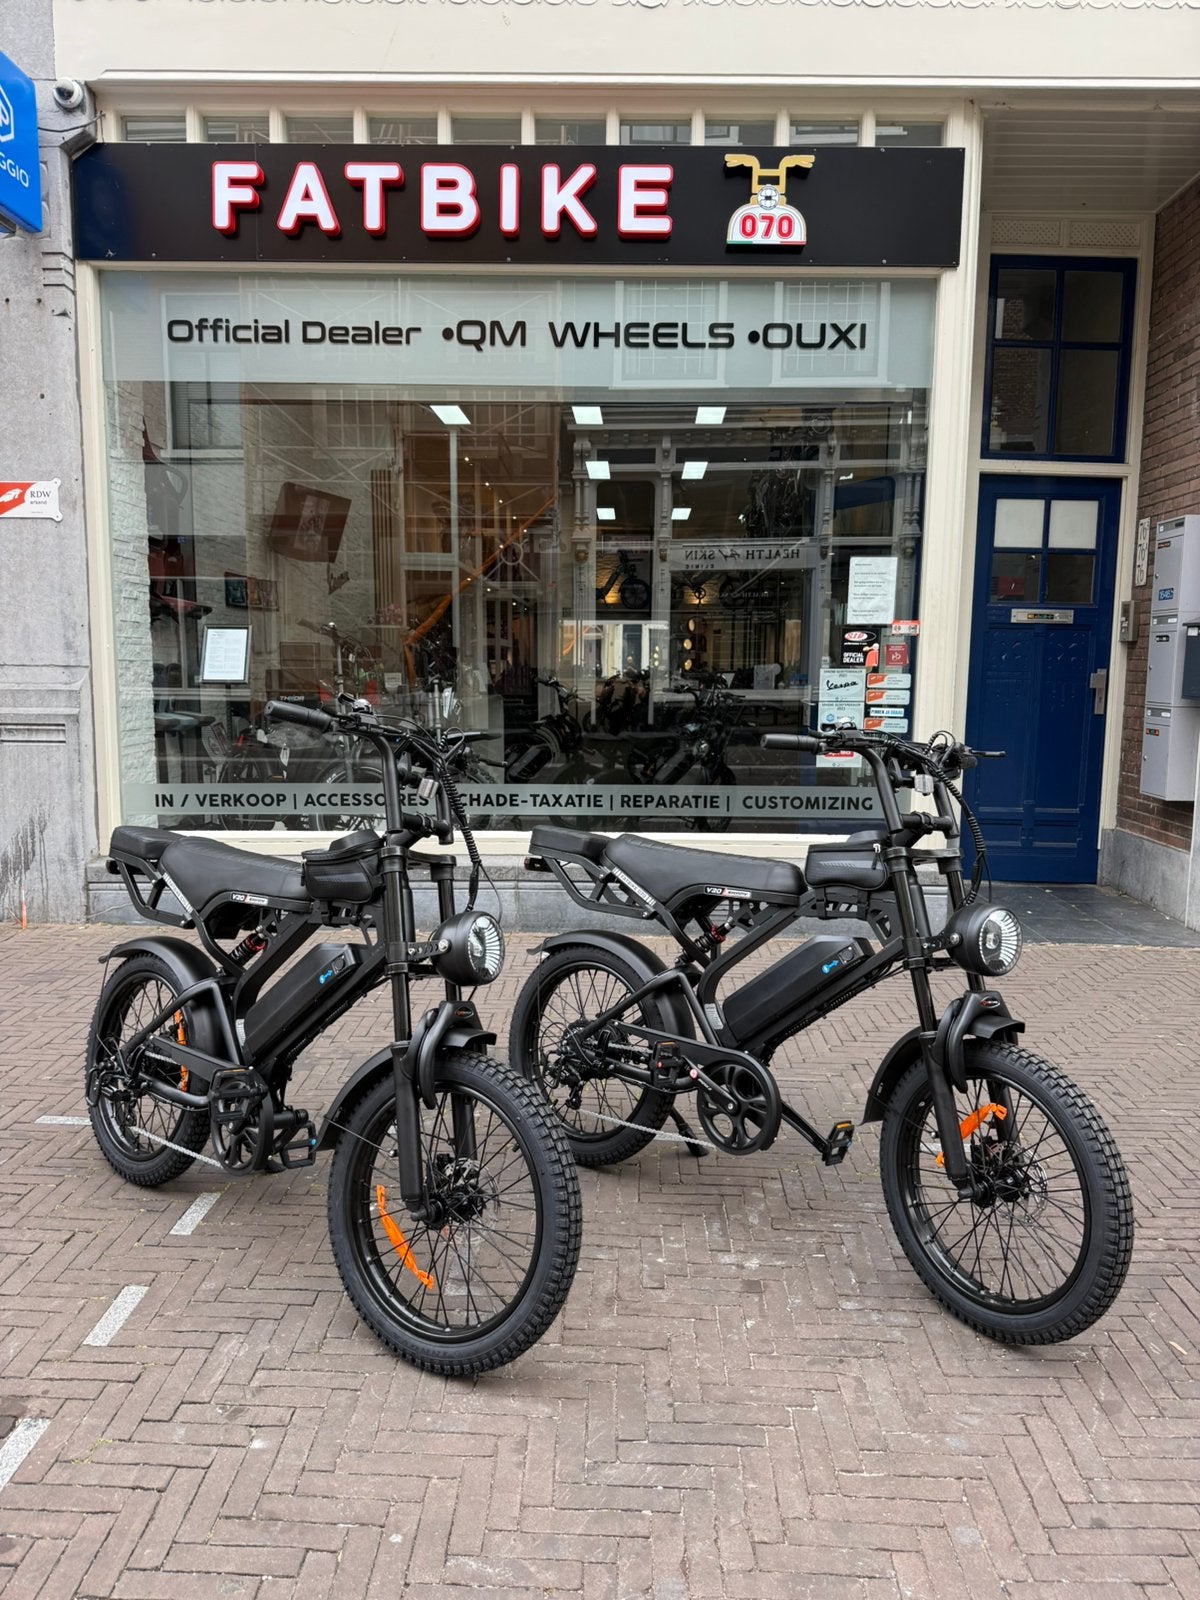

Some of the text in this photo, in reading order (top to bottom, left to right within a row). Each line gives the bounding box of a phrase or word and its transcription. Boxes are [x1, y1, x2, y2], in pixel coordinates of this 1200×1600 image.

[212, 161, 674, 237] FATBIKE
[740, 213, 795, 239] 070
[167, 318, 290, 343] Official
[301, 320, 422, 345] Dealer
[548, 321, 735, 349] WHEELS
[30, 490, 51, 498] RDW
[826, 680, 859, 691] Vespa
[155, 793, 174, 807] IN
[195, 793, 287, 807] VERKOOP
[304, 793, 430, 807] ACCESSORES
[456, 793, 604, 808] CHADE-TAXATIE
[620, 794, 720, 809] REPARATIE
[742, 795, 874, 811] CUSTOMIZING
